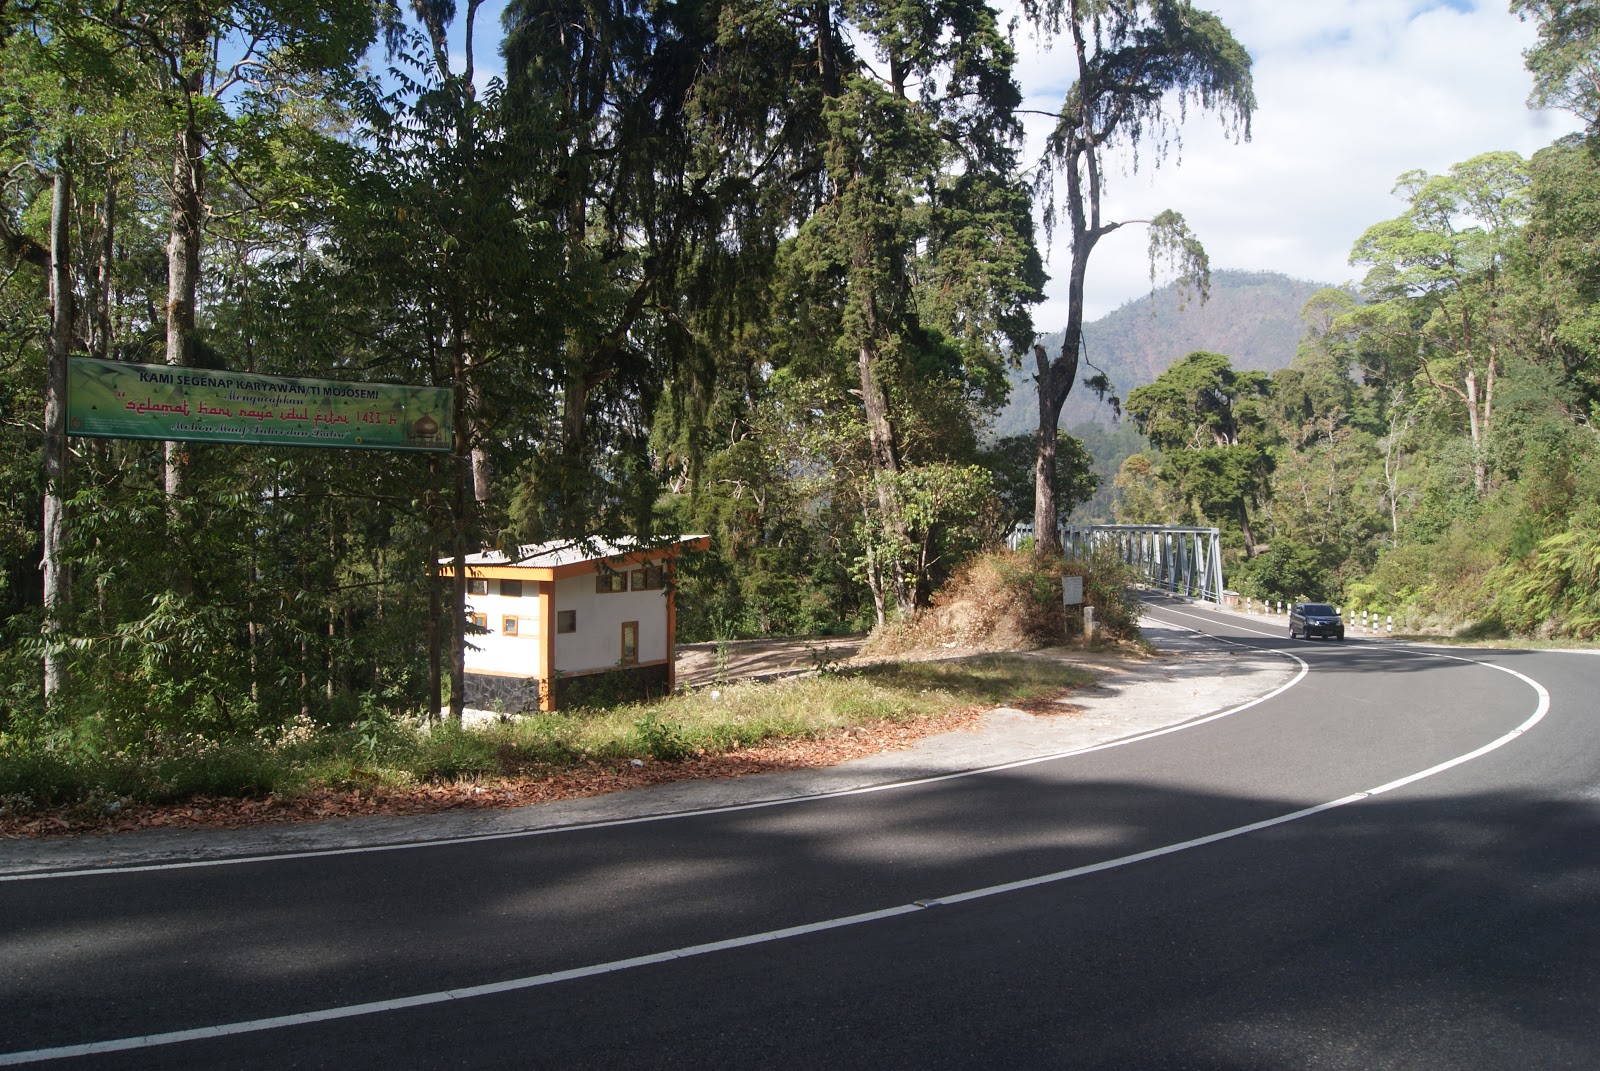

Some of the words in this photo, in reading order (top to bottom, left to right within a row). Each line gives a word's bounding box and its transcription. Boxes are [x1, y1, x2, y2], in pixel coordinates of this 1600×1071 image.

[139, 371, 174, 384] KAMI
[176, 375, 233, 388] SEGENAP
[236, 380, 320, 397] KARYAWAN/TI
[323, 387, 379, 400] MOJOSEMI
[224, 391, 304, 408] Mengucapkan
[356, 410, 381, 425] 1433
[171, 420, 213, 432] Mohon
[215, 423, 248, 438] Maaf
[285, 427, 308, 437] dan
